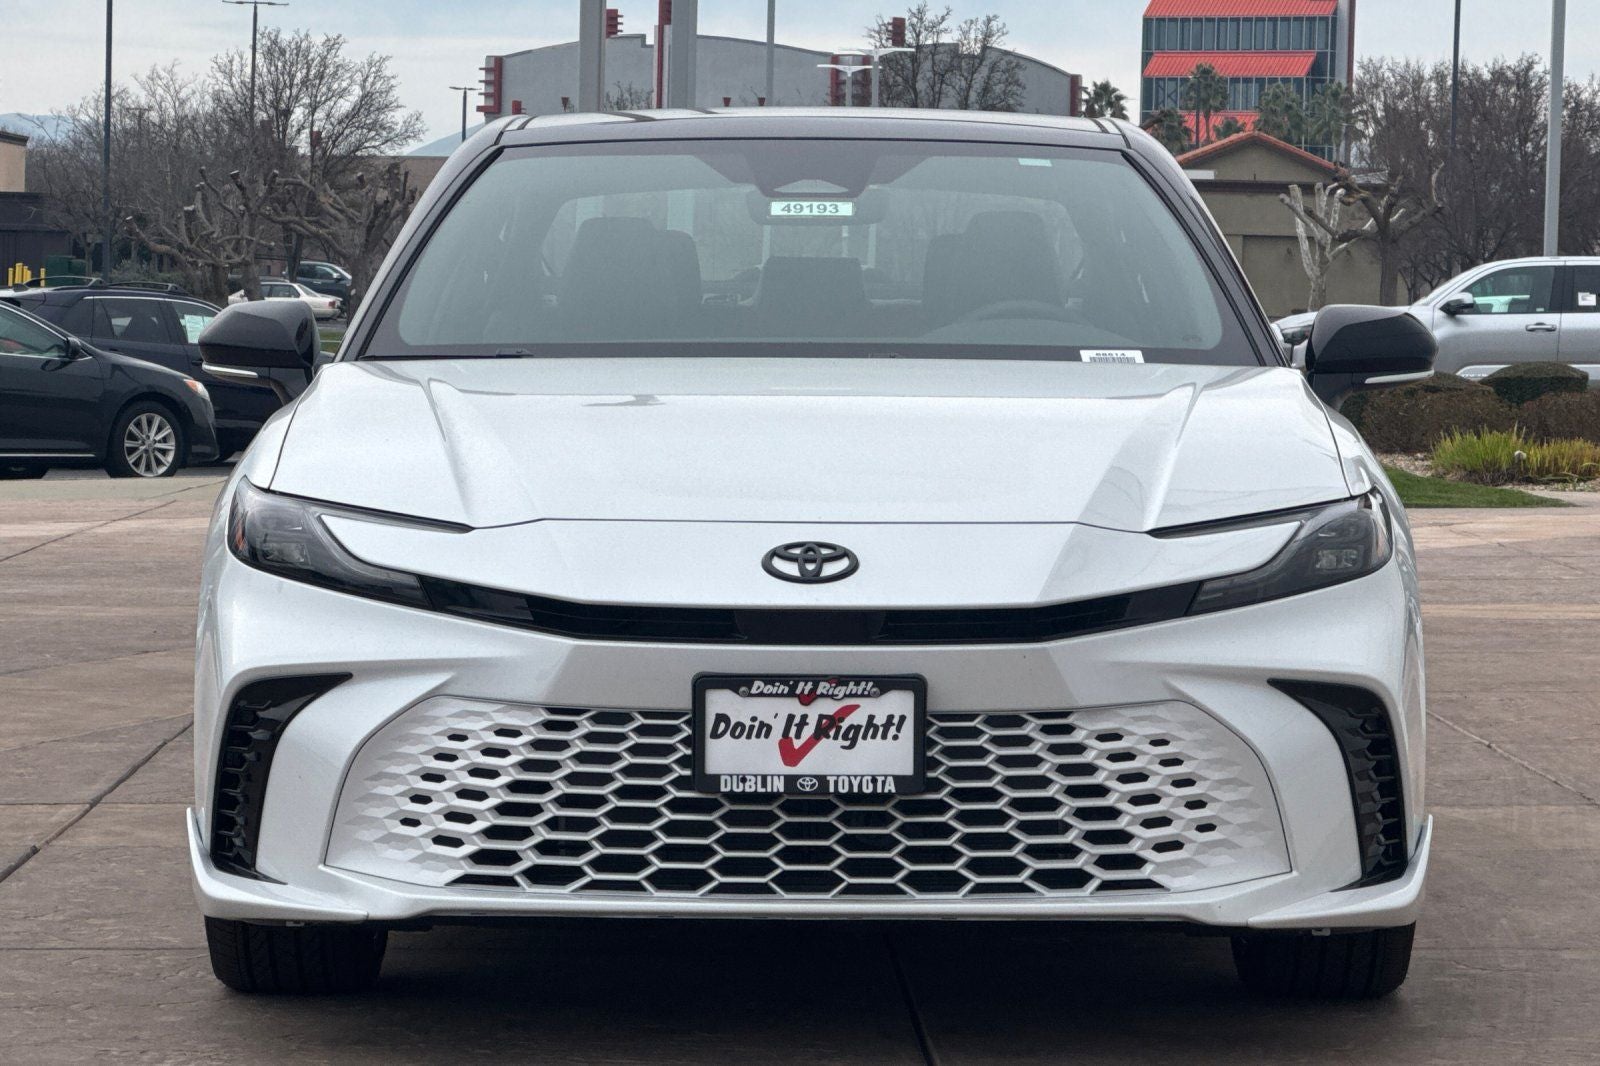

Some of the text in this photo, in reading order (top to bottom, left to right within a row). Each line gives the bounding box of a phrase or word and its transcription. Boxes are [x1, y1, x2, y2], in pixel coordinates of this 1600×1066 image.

[781, 203, 840, 214] 49193
[796, 681, 814, 695] It
[816, 681, 873, 699] Right!
[782, 713, 809, 740] It
[814, 714, 907, 750] Right!
[720, 775, 896, 793] DUBLIN TOYOTA
